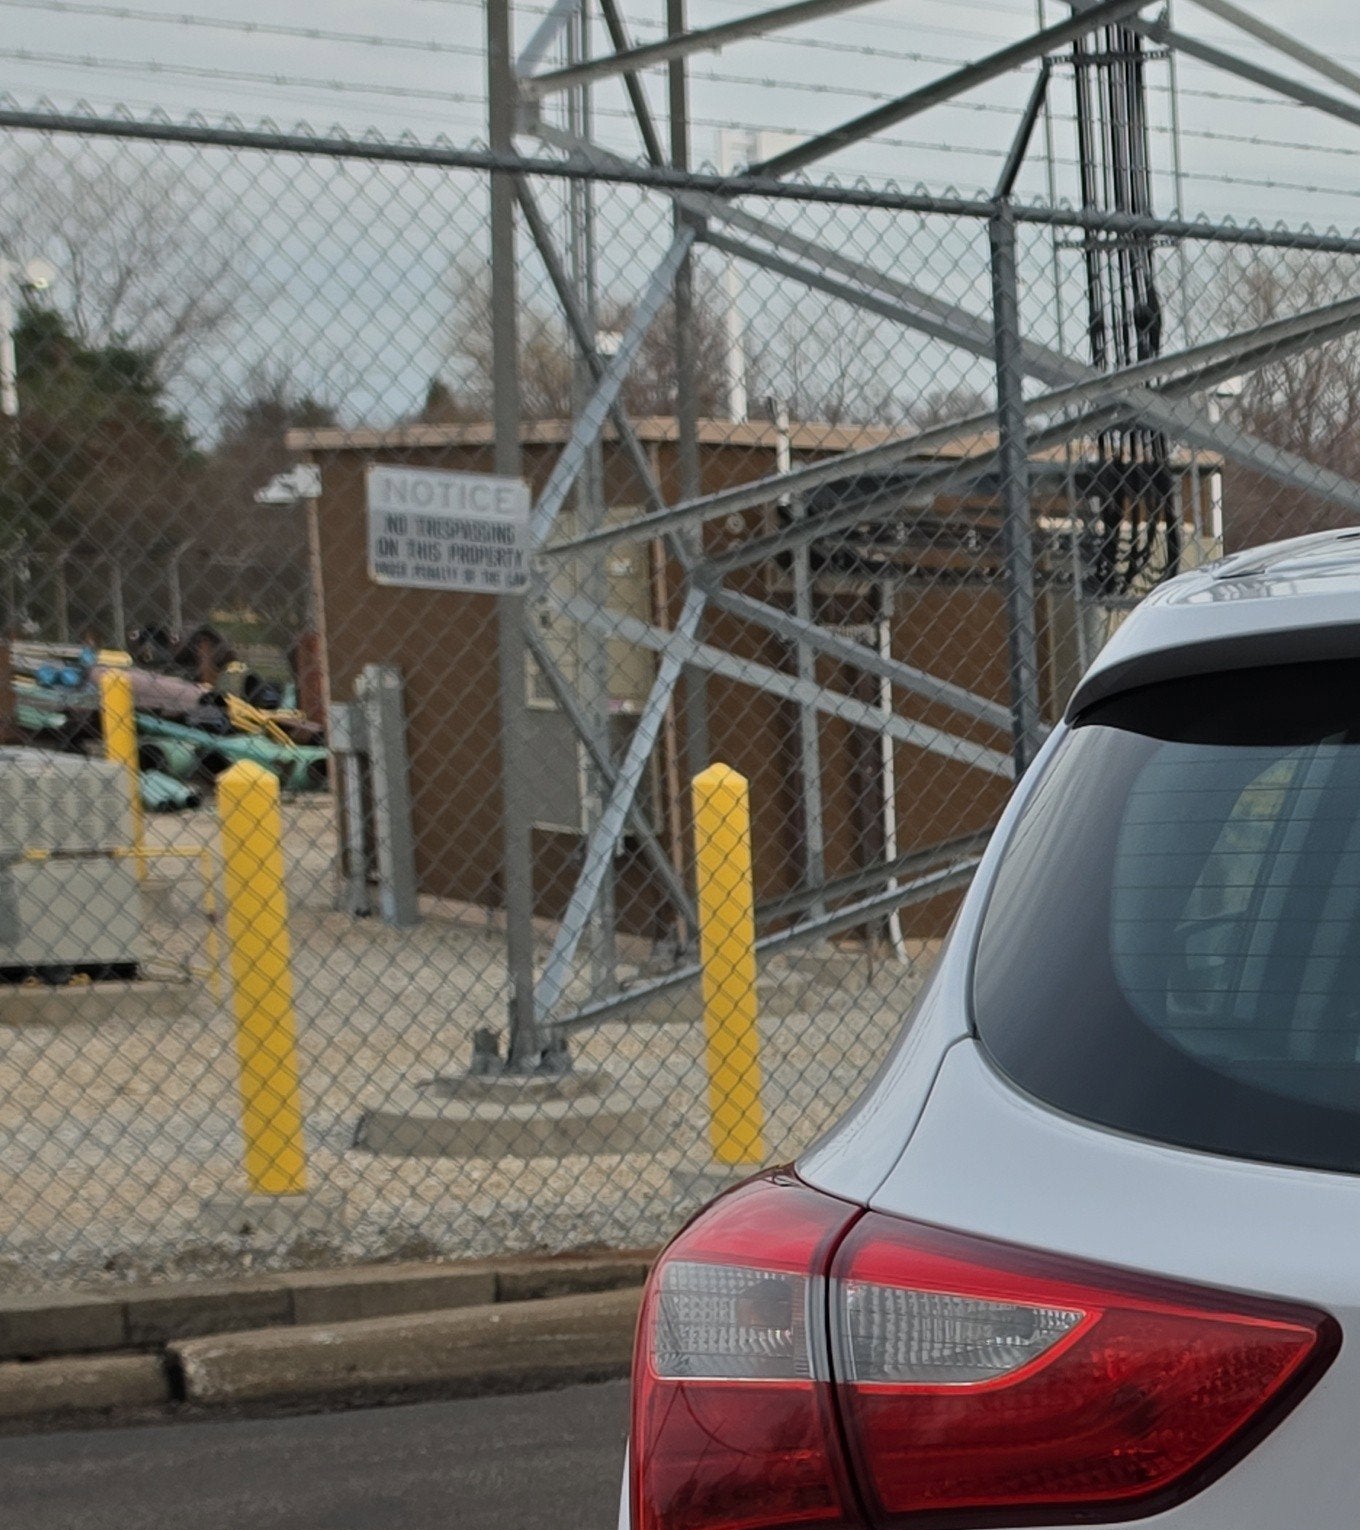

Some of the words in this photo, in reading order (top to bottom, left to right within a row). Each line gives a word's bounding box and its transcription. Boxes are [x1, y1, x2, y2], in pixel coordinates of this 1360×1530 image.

[383, 477, 516, 514] NOTICE
[385, 512, 407, 535] NO
[415, 514, 516, 545] TRESPASSING
[376, 536, 399, 558] ON
[406, 539, 442, 562] THIS
[449, 544, 524, 568] PROPERTY
